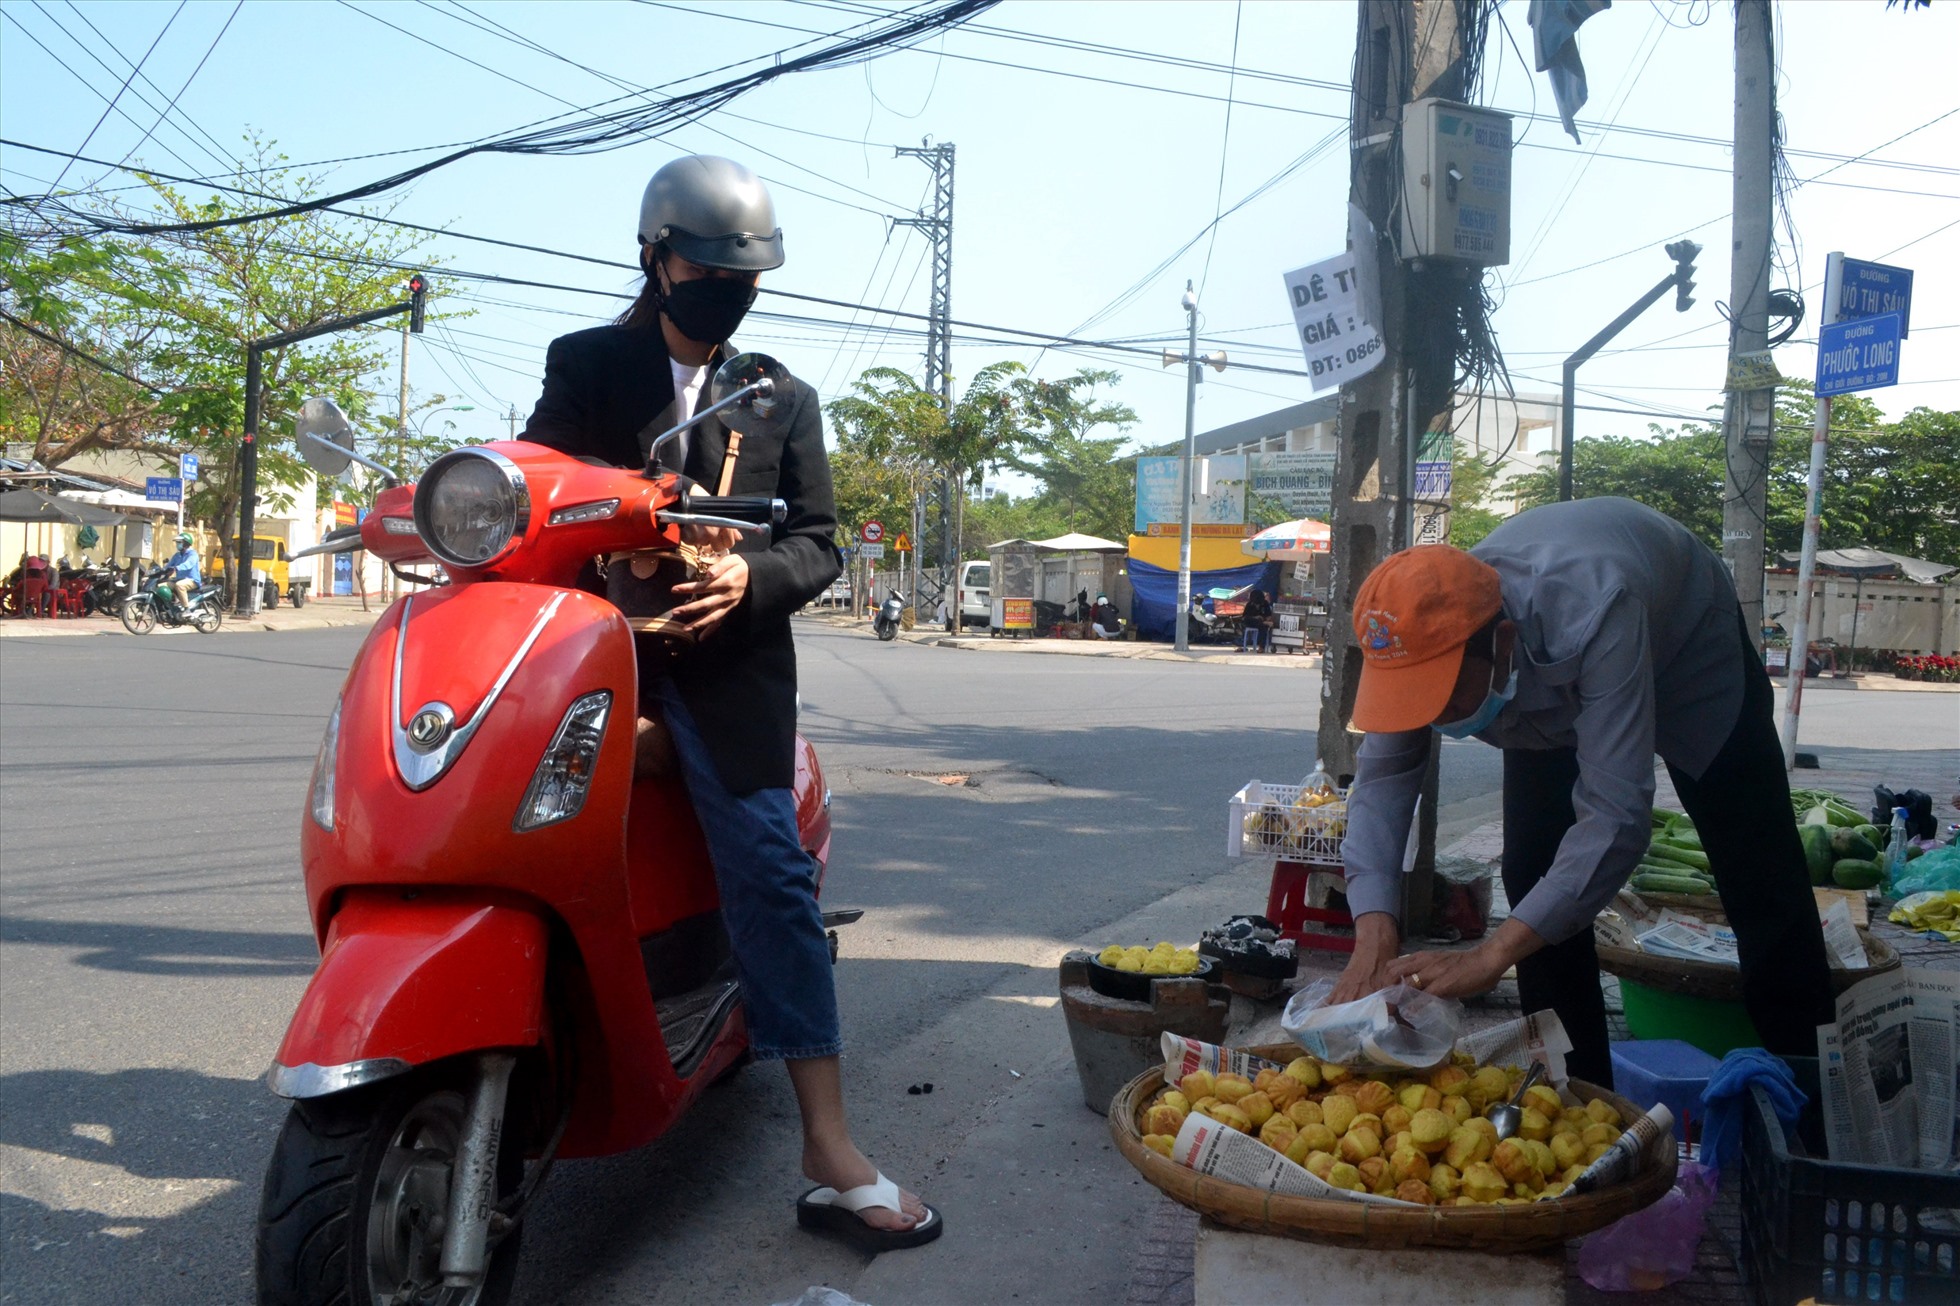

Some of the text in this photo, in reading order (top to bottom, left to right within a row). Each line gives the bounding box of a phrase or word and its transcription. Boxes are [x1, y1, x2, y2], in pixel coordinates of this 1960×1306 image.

[1292, 273, 1328, 308] DÊ
[1860, 269, 1890, 284] ĐƯỜNG
[1842, 281, 1857, 310] VÕ
[1303, 312, 1341, 345] GIÁ
[1844, 325, 1875, 339] ĐƯỜNG
[1822, 340, 1894, 375] PHƯỚC LONG
[1256, 474, 1277, 489] BÍCH
[1279, 476, 1310, 489] QUANG
[477, 1118, 501, 1221] DYNAMIC
